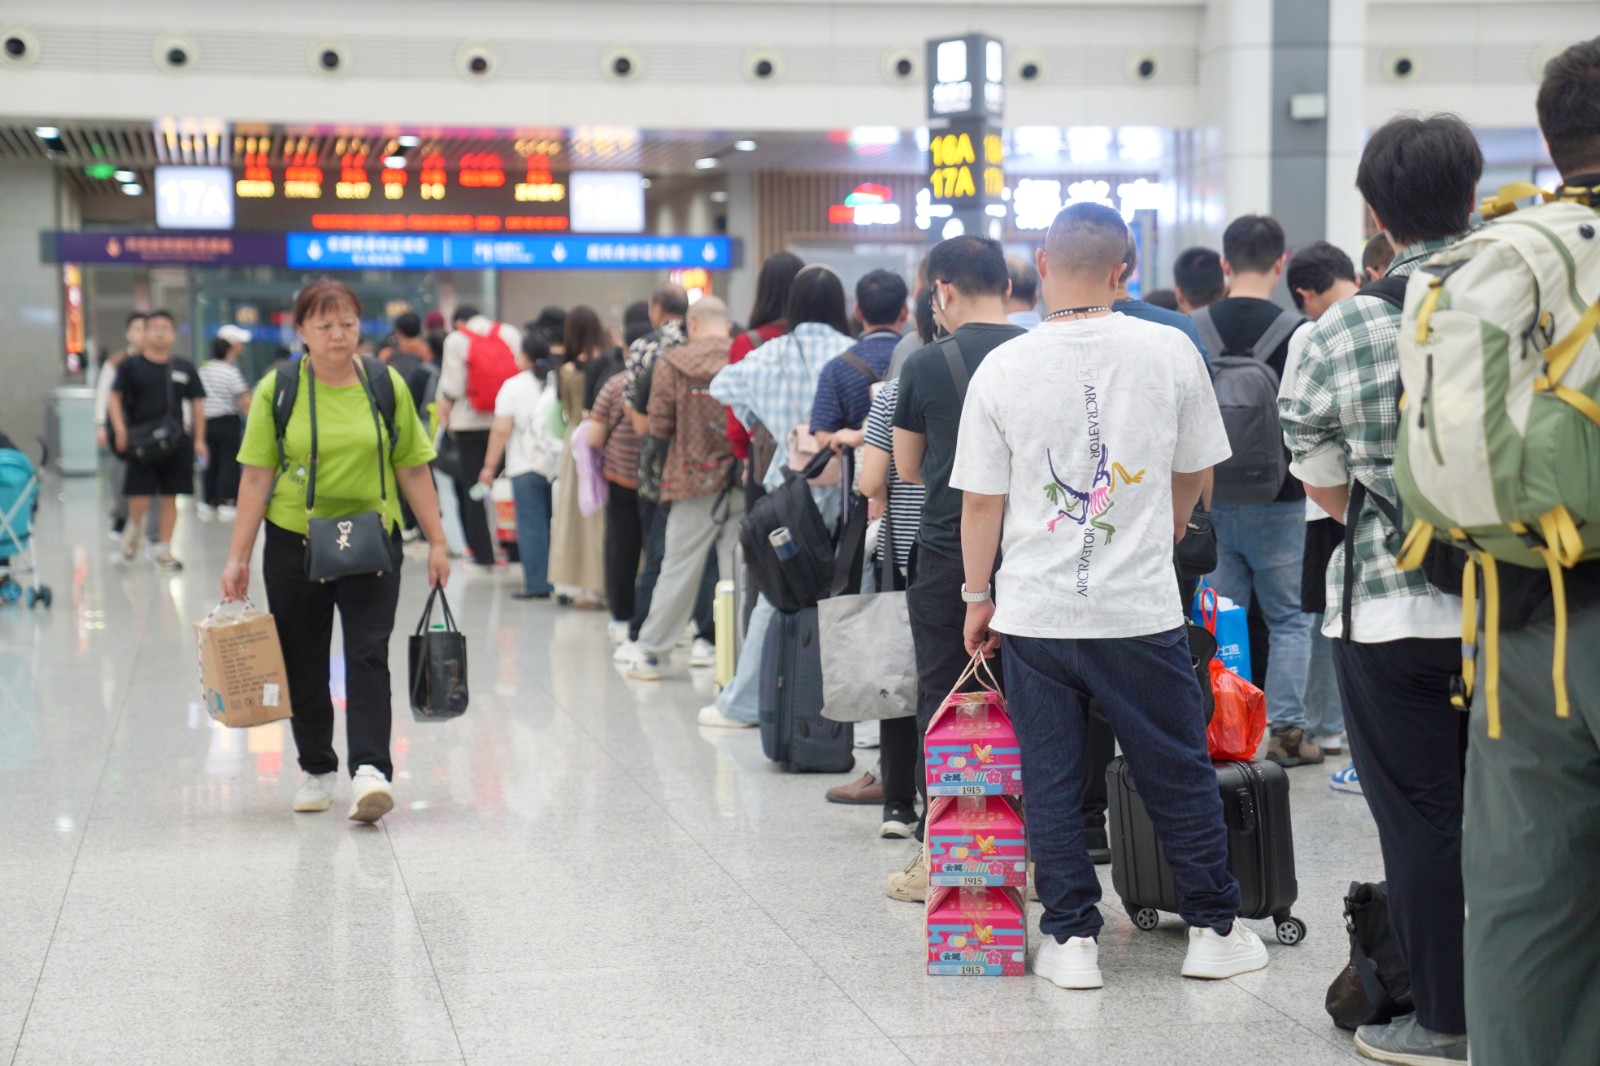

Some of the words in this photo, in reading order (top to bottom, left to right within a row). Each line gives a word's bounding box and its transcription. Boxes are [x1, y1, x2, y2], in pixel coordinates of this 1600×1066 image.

[930, 166, 976, 199] 17A
[159, 179, 231, 217] 17A
[962, 786, 981, 795] 1915
[963, 877, 983, 885] 1915
[961, 966, 981, 975] 1915
